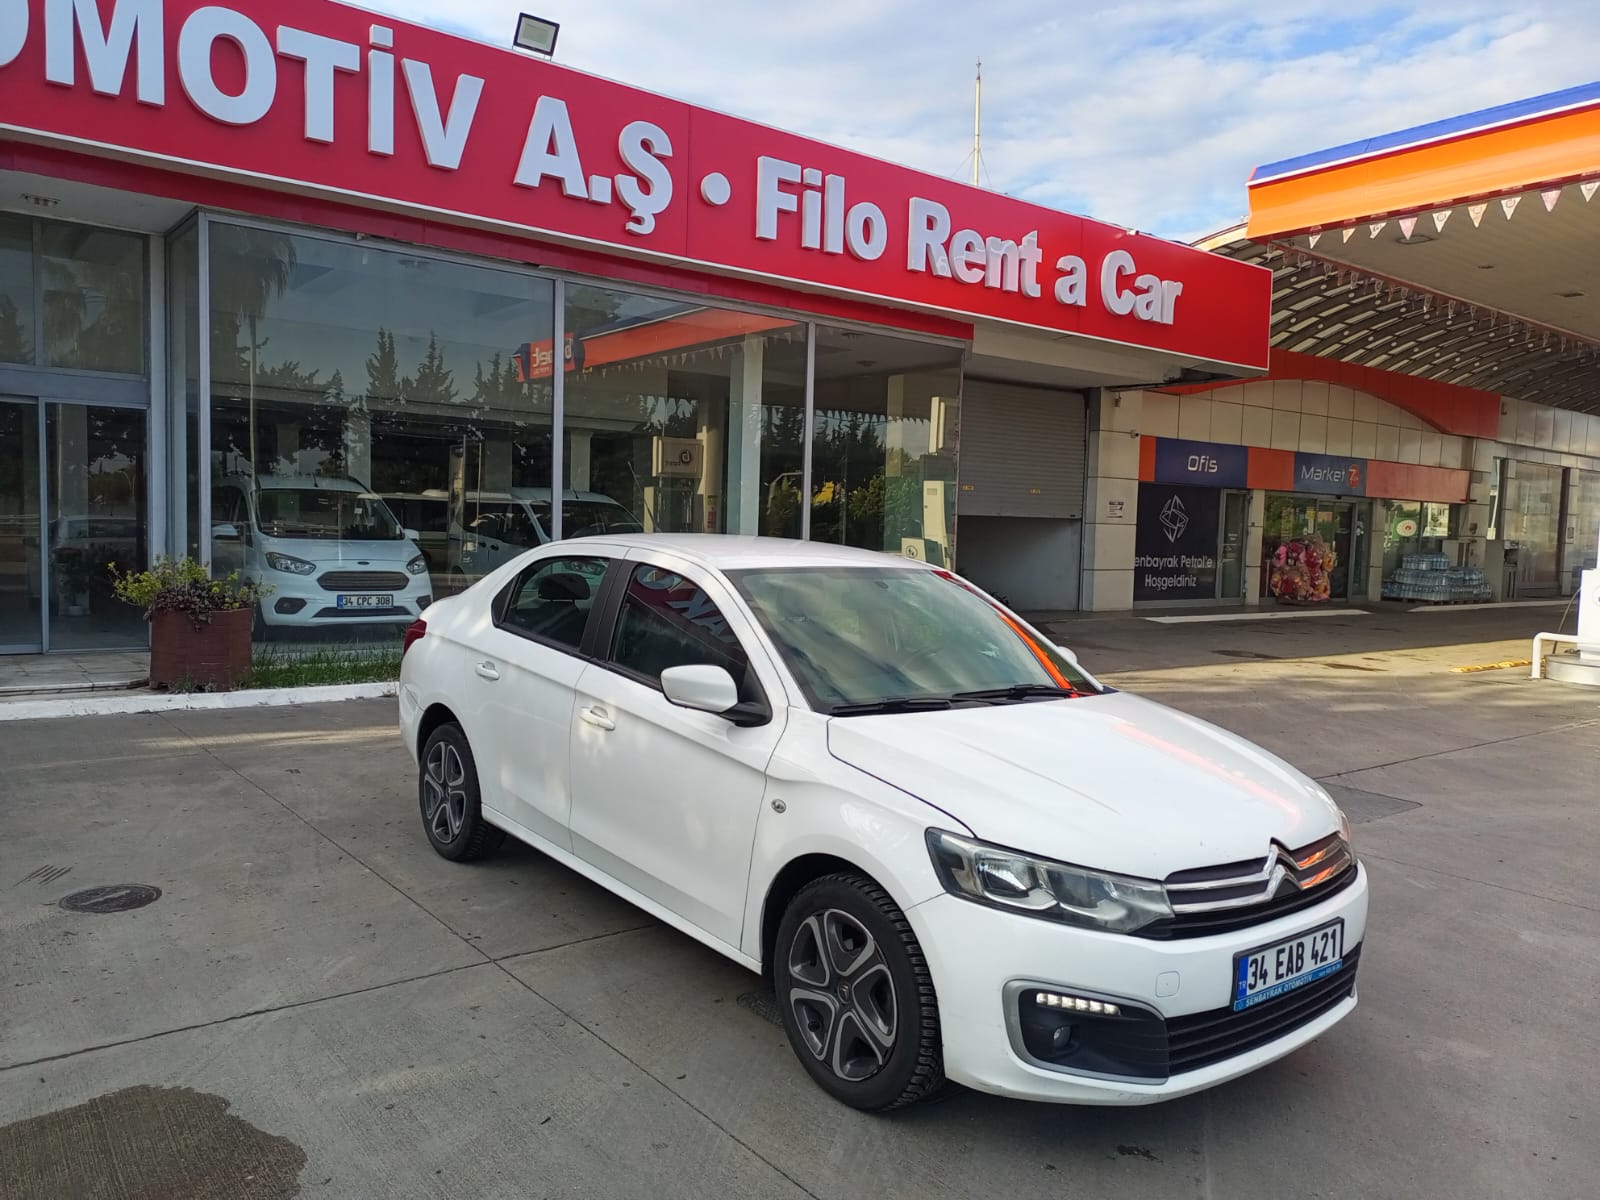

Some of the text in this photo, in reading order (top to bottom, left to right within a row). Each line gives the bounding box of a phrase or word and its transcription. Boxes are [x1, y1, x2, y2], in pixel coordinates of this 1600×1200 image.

[513, 96, 673, 235] A.Ş
[756, 156, 887, 261] Filo
[907, 197, 1042, 299] Rent
[1055, 255, 1087, 307] a
[1100, 250, 1184, 325] Car
[1187, 455, 1218, 473] Ofis
[1301, 465, 1345, 482] Market
[343, 596, 353, 606] 34
[357, 596, 372, 606] CPC
[1248, 955, 1268, 991] 34
[1275, 941, 1304, 982] EAB
[1310, 928, 1337, 965] 421
